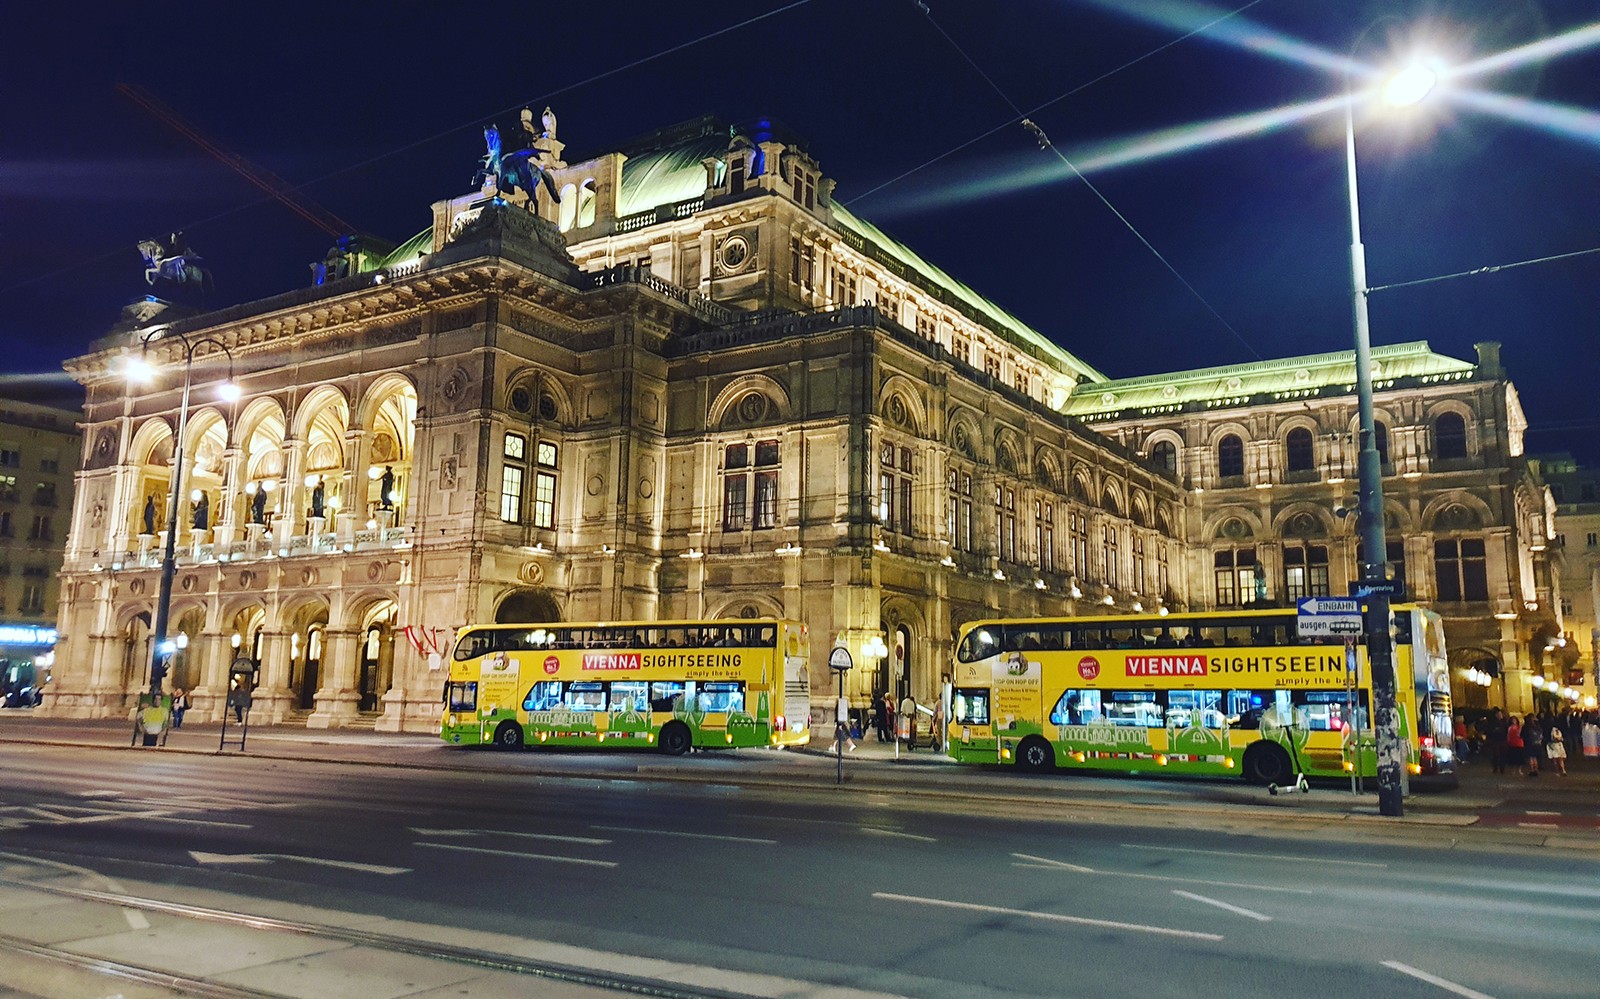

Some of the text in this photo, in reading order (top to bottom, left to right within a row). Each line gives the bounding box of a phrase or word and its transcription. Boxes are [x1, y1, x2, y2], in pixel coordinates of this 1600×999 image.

[1318, 601, 1354, 611] EINBAHN
[584, 654, 742, 669] VIENNA SIGHTSEEING
[1128, 656, 1342, 675] VIENNA SIGHTSEEIN
[686, 670, 709, 678] simply
[1275, 676, 1355, 686] simply the bes
